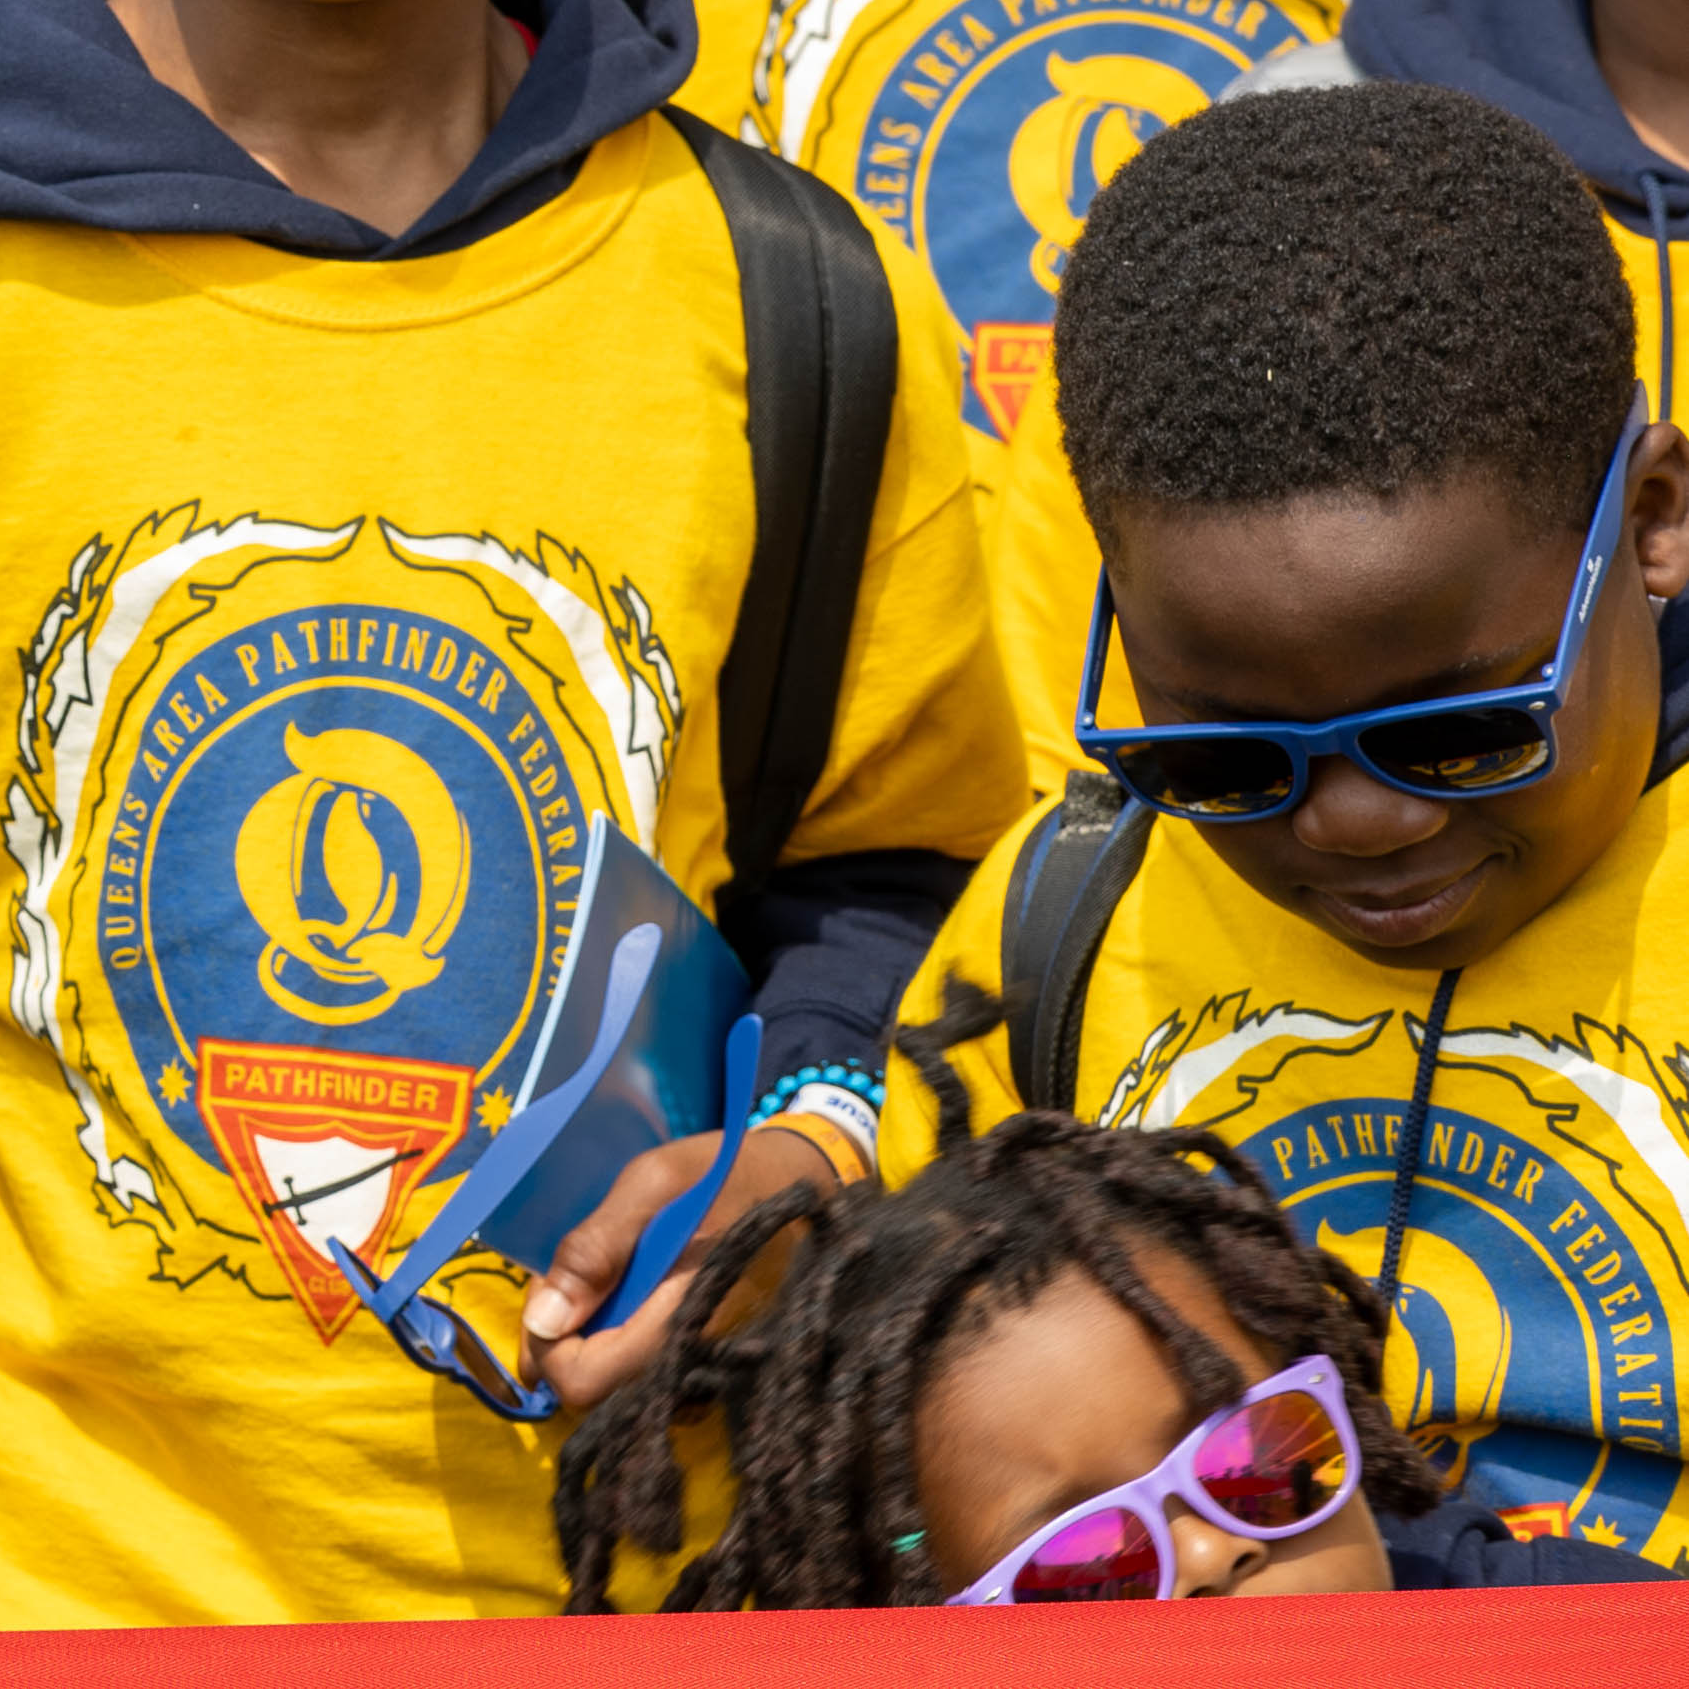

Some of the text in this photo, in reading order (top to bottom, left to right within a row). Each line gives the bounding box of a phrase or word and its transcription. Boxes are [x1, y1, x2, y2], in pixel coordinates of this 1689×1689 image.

[900, 13, 995, 110] AREA
[110, 791, 153, 972] QUEENS
[145, 668, 230, 781] AREA
[236, 618, 509, 715] PATHFINDER
[223, 1063, 441, 1112] PATHFINDER
[1271, 1112, 1545, 1206] PATHFNDER
